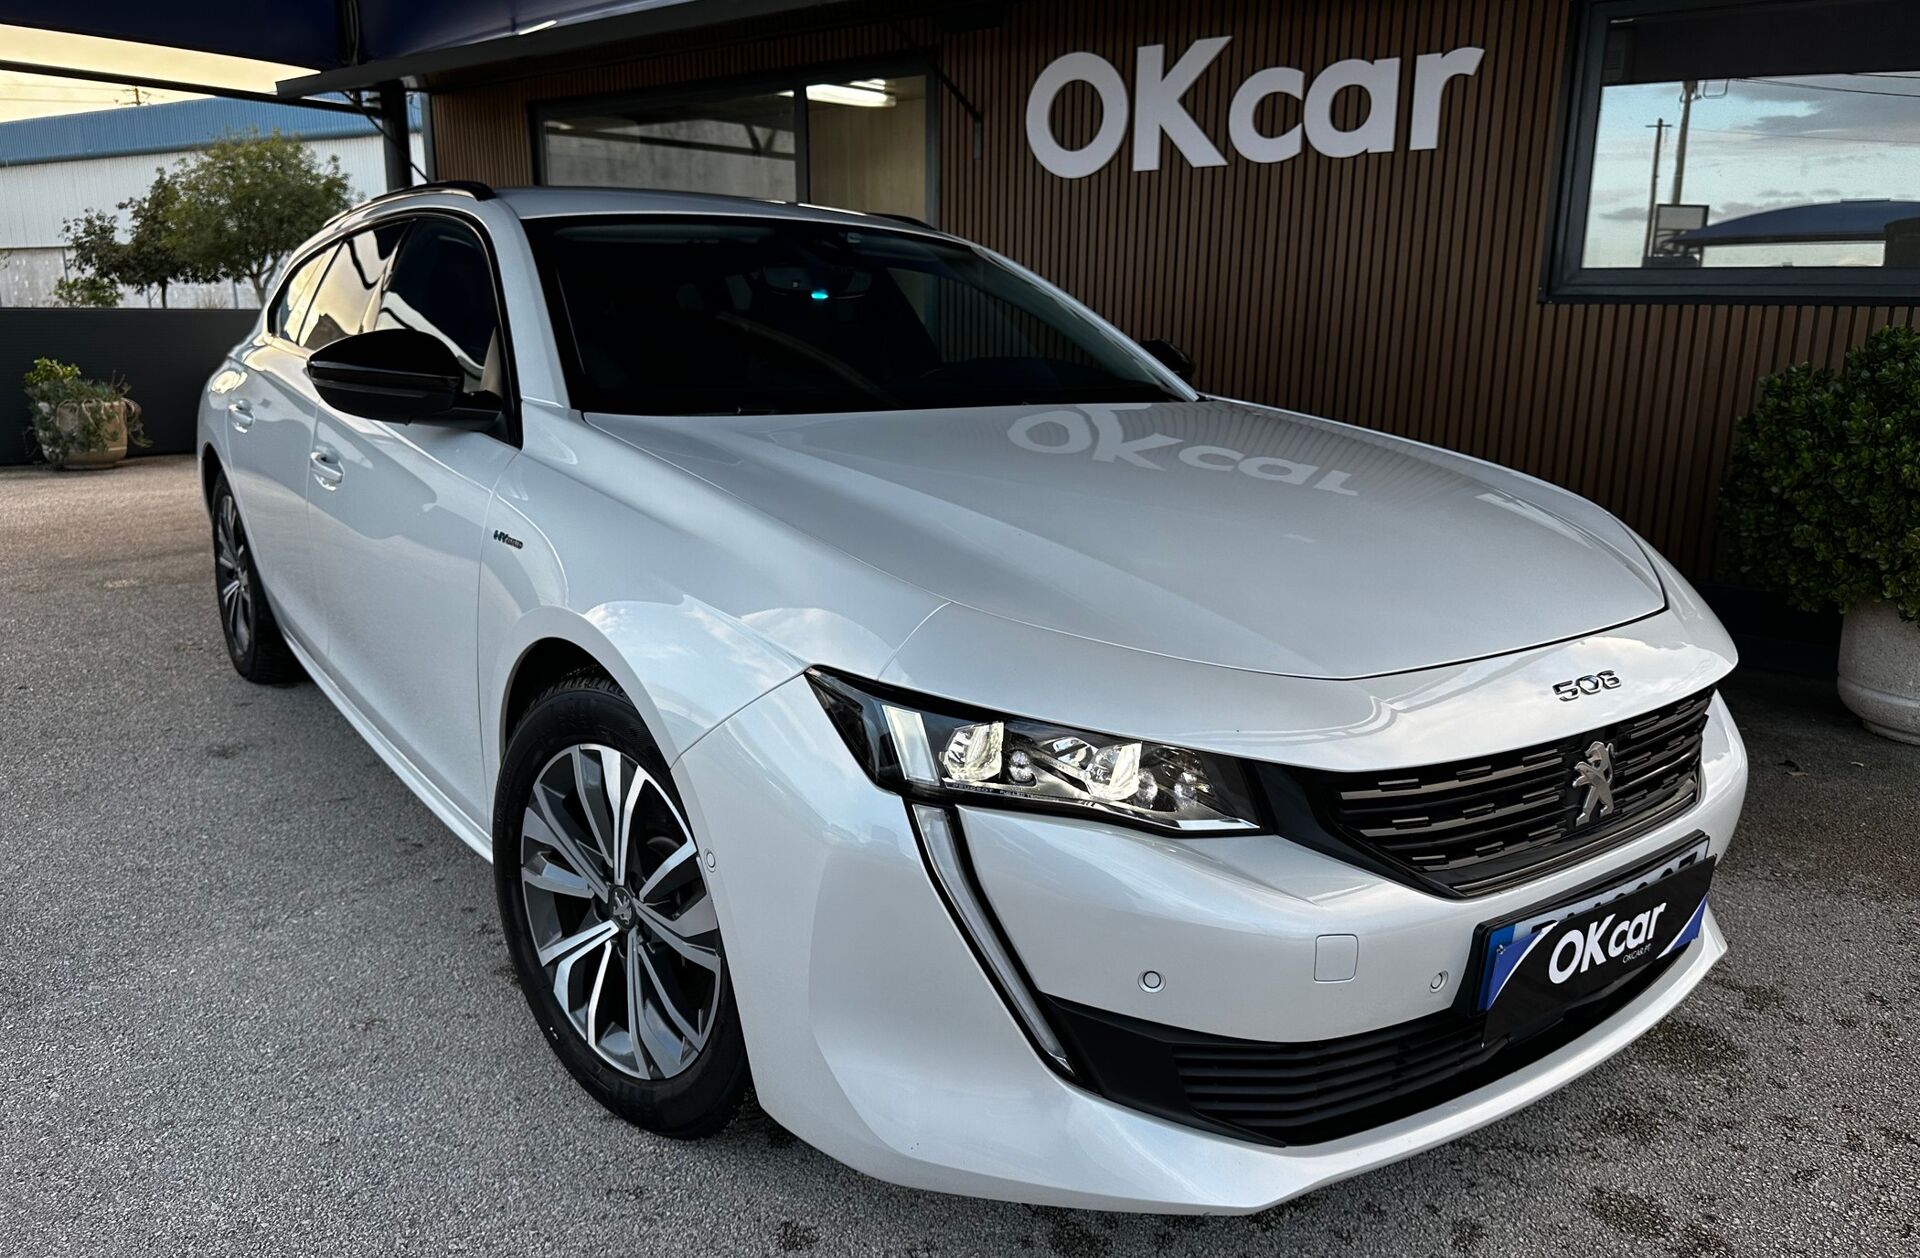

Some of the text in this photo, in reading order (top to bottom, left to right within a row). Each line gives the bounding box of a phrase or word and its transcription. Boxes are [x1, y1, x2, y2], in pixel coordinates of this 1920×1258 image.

[1026, 36, 1485, 179] OKcar
[1552, 669, 1622, 702] 506
[1548, 902, 1667, 984] OKcar
